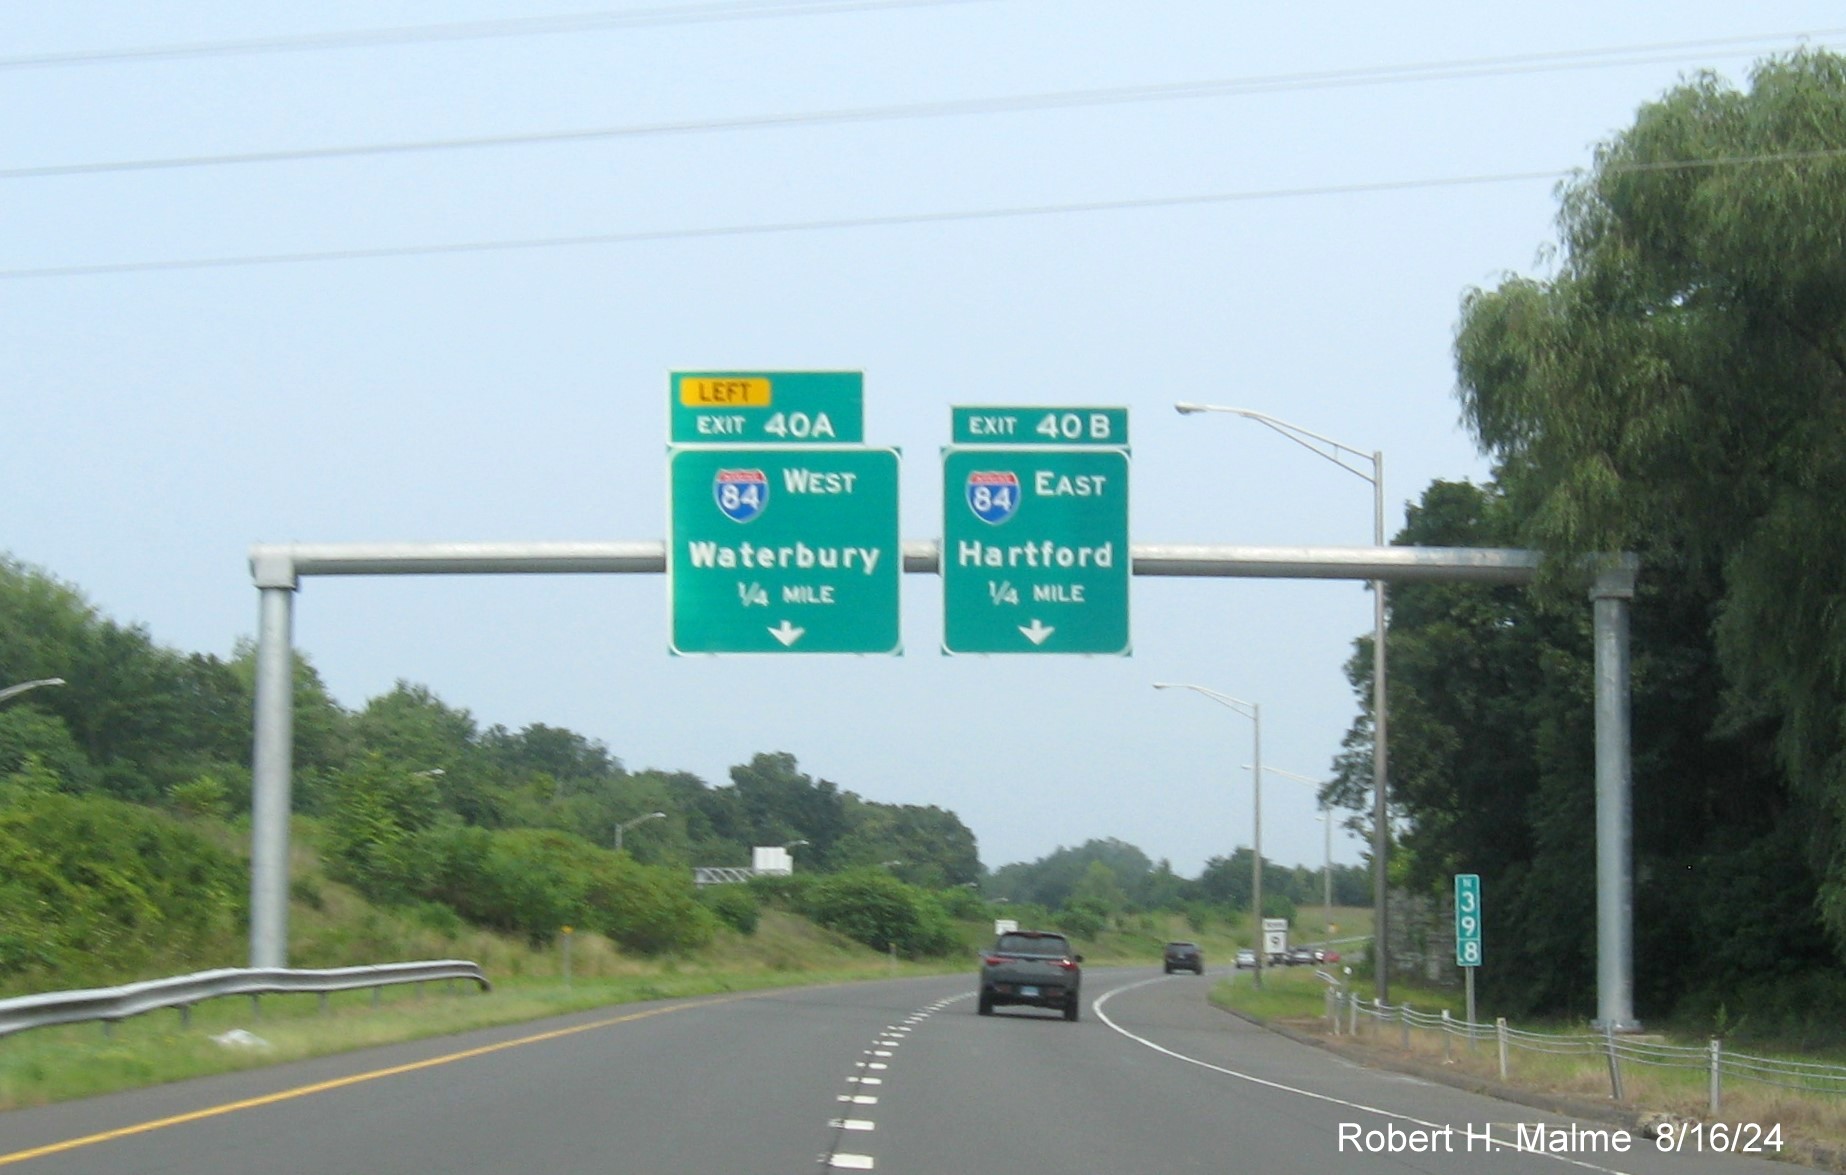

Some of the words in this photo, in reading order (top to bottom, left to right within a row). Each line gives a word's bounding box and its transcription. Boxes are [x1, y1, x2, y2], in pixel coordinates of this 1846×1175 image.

[699, 381, 751, 402] LEFT
[697, 415, 745, 435] EXIT
[764, 412, 836, 439] 40A
[969, 415, 1017, 435] EXIT
[783, 467, 857, 494] WEST
[1035, 470, 1106, 496] EAST
[721, 484, 760, 511] 84
[973, 486, 1012, 512] 84
[689, 541, 880, 574] Waterbury
[958, 541, 1113, 567] Hartford
[783, 585, 835, 604] MILE
[1033, 584, 1084, 603] MILE
